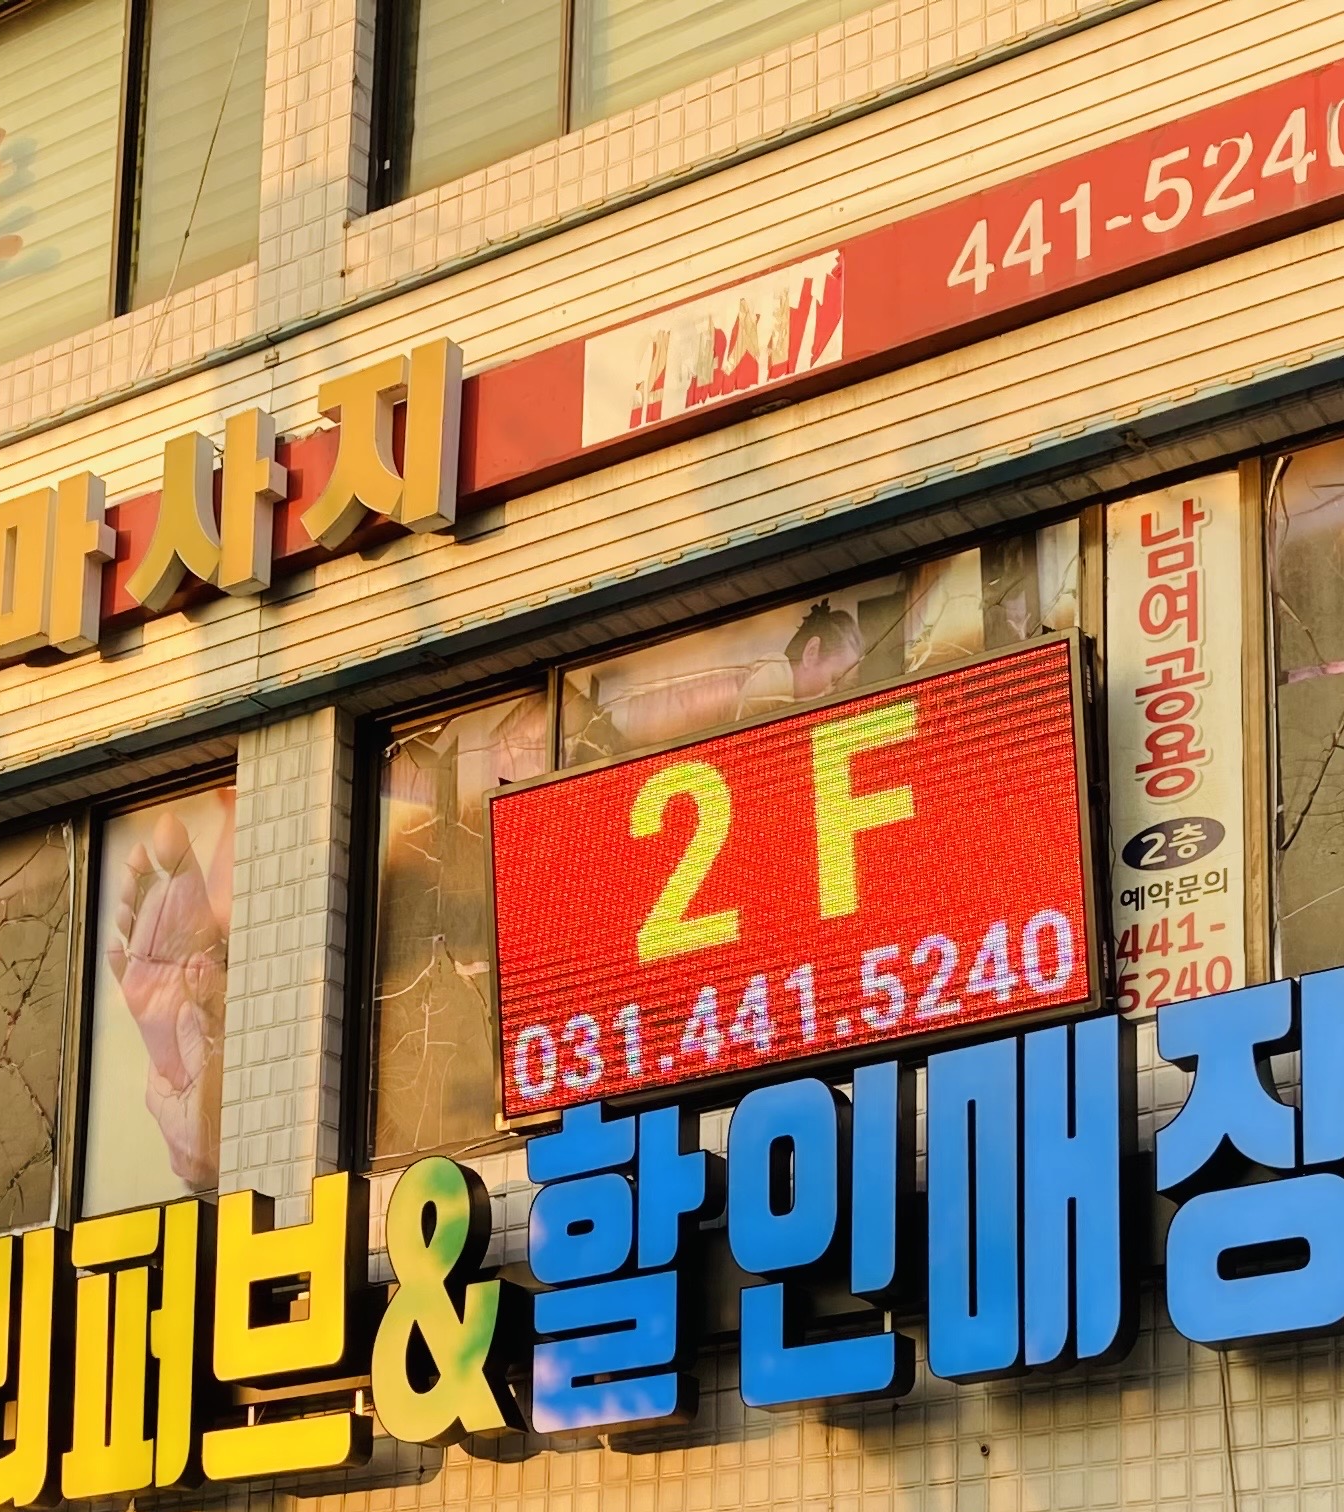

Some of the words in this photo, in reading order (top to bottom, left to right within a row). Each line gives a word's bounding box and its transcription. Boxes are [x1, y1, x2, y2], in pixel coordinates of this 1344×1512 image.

[1133, 497, 1208, 801] 남여공용
[1139, 819, 1209, 866] 2층
[1119, 867, 1230, 912] 예약문의
[1117, 910, 1226, 965] 441-
[510, 908, 1077, 1103] 031.441.5240
[1117, 954, 1234, 1015] 5240
